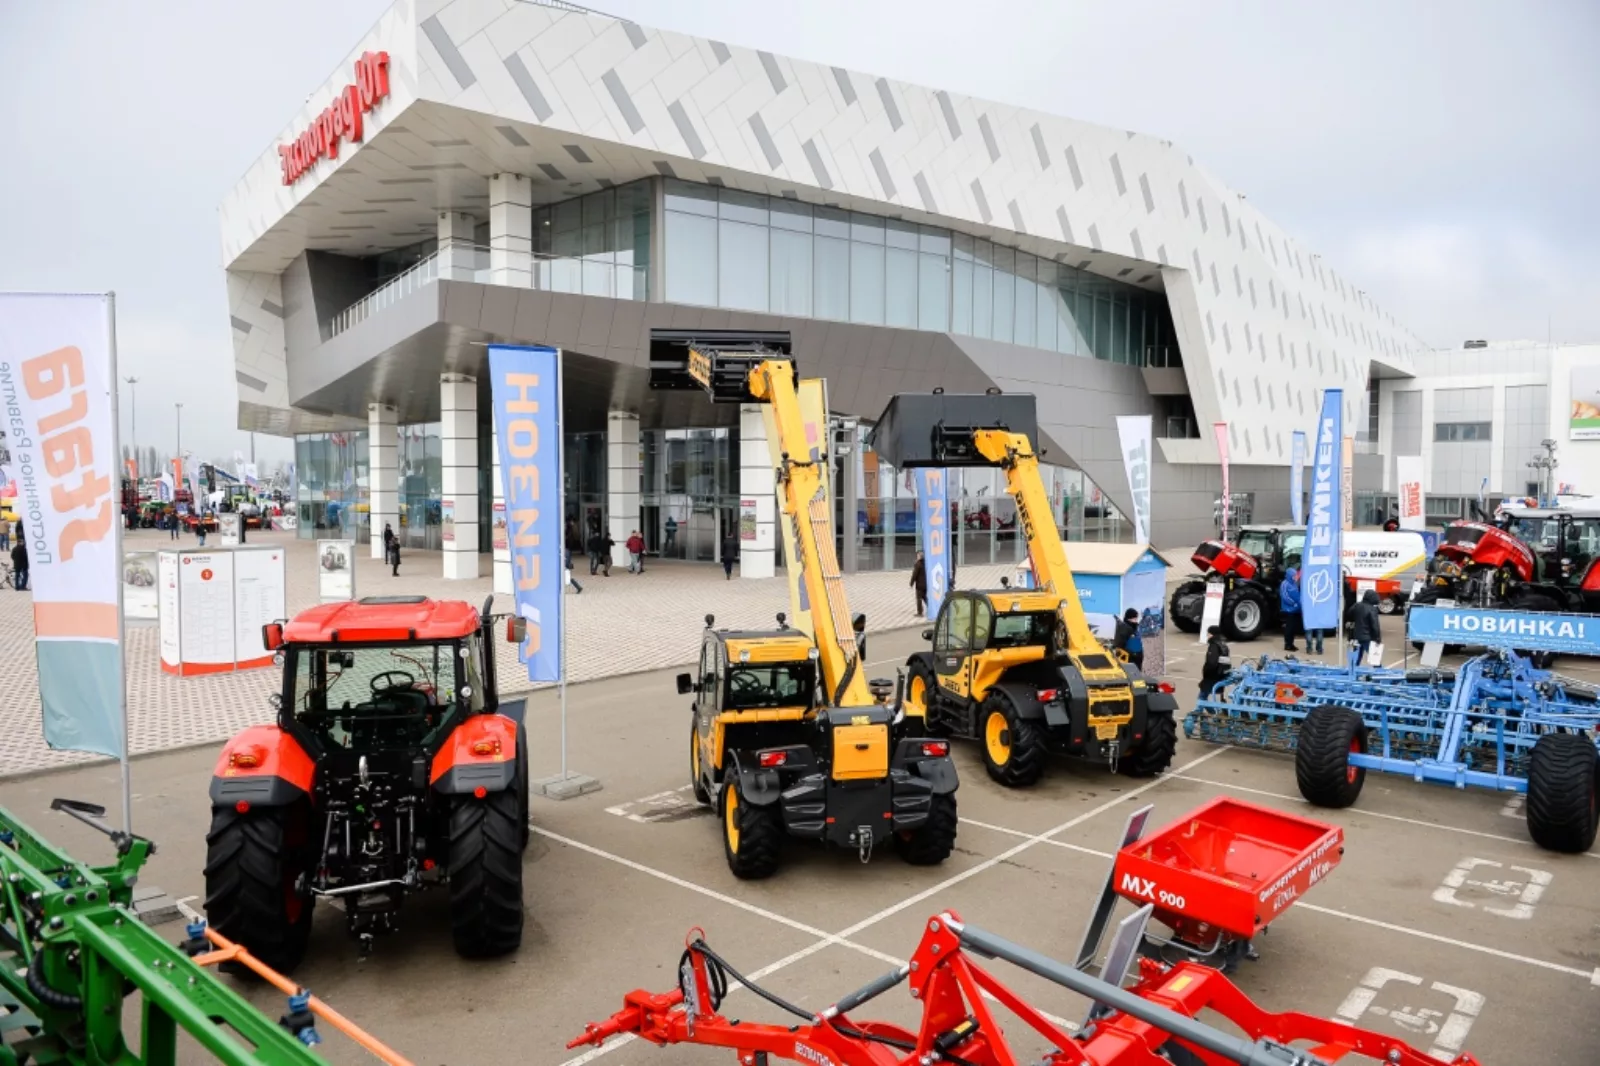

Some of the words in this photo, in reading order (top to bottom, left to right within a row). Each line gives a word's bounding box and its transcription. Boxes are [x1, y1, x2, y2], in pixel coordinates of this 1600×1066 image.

[1370, 551, 1399, 559] DIECI
[1443, 613, 1585, 639] НОВИНКА!
[1121, 873, 1157, 900] MX
[1159, 890, 1186, 910] 900
